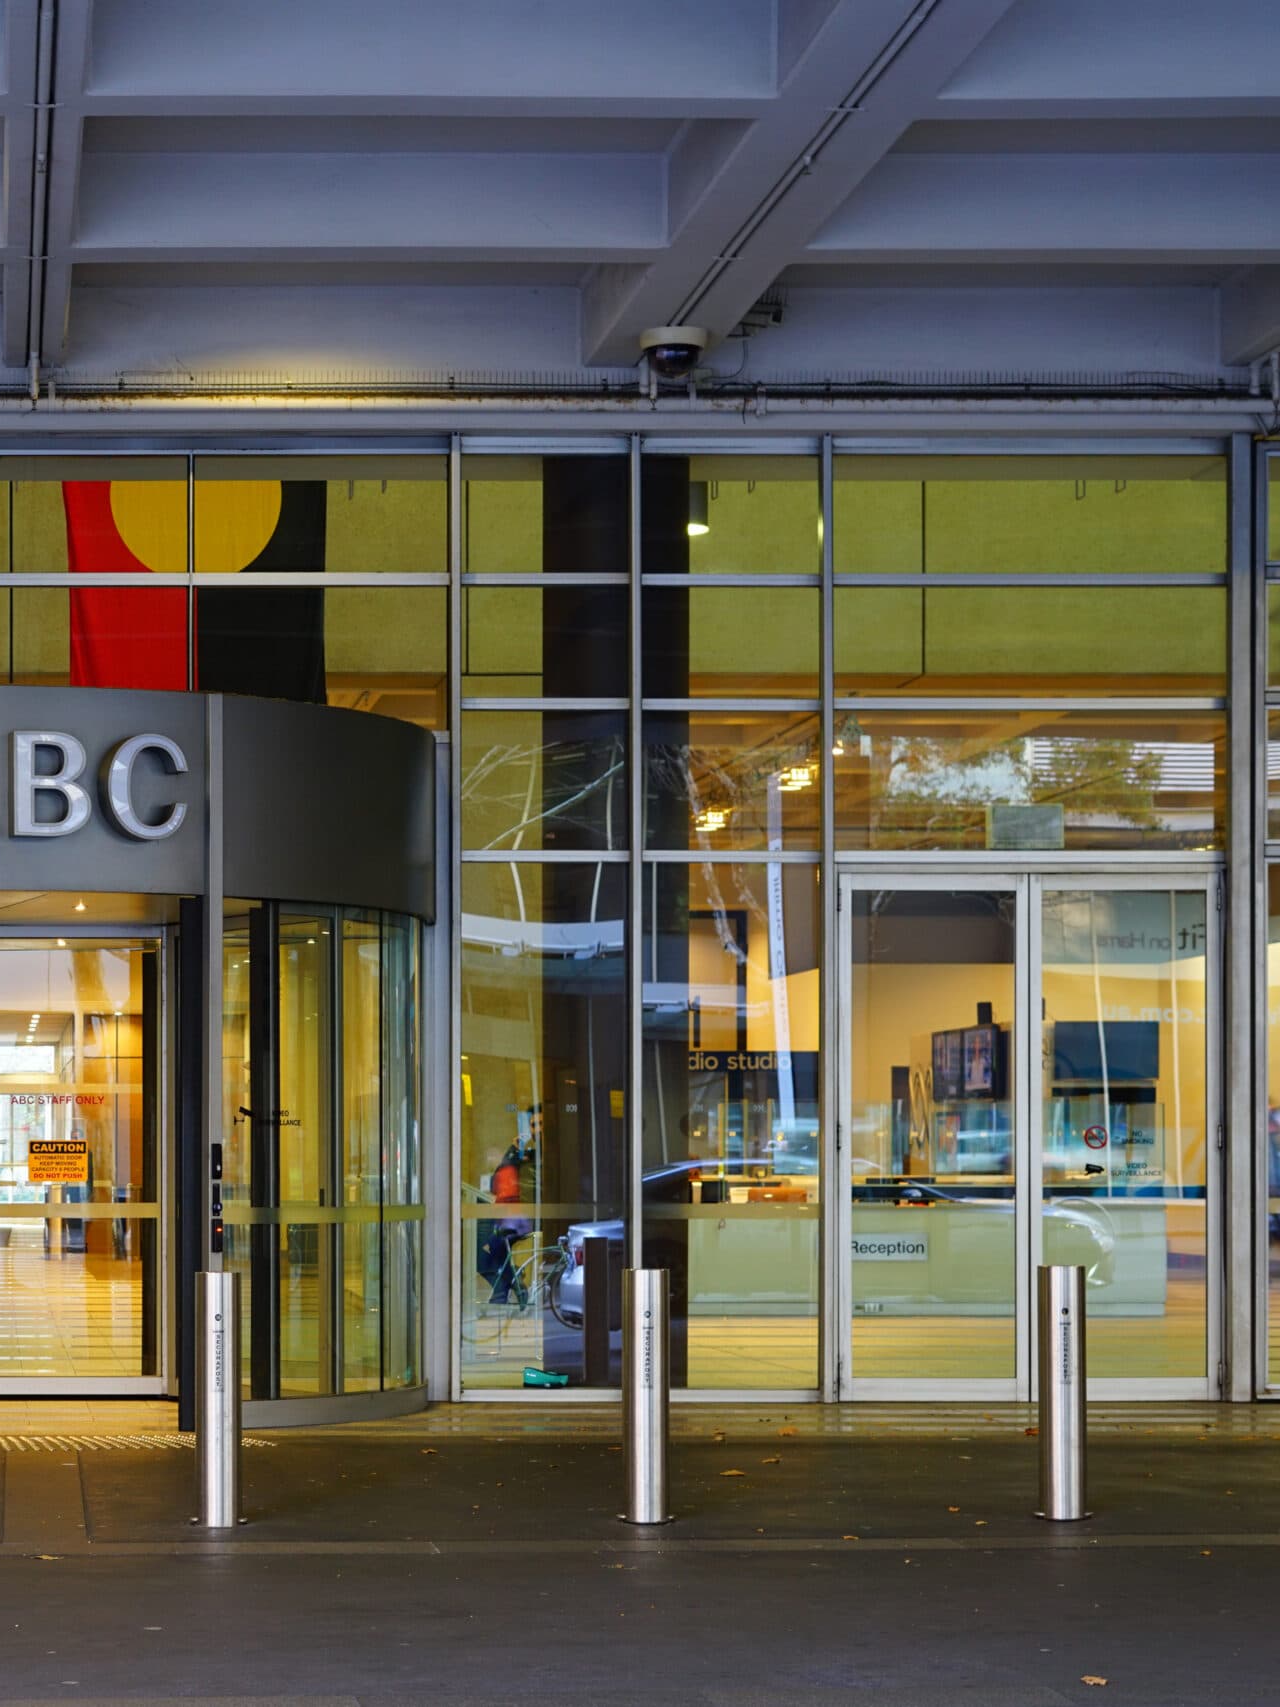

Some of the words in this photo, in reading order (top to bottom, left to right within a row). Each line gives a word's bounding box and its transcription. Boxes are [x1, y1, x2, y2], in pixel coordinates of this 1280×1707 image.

[688, 1052, 719, 1071] dio
[727, 1052, 792, 1071] studio
[10, 1095, 35, 1105] ABC
[38, 1095, 72, 1105] STAFF
[75, 1095, 105, 1105] ONLY
[32, 1143, 85, 1152] CAUTION
[851, 1240, 925, 1256] Reception
